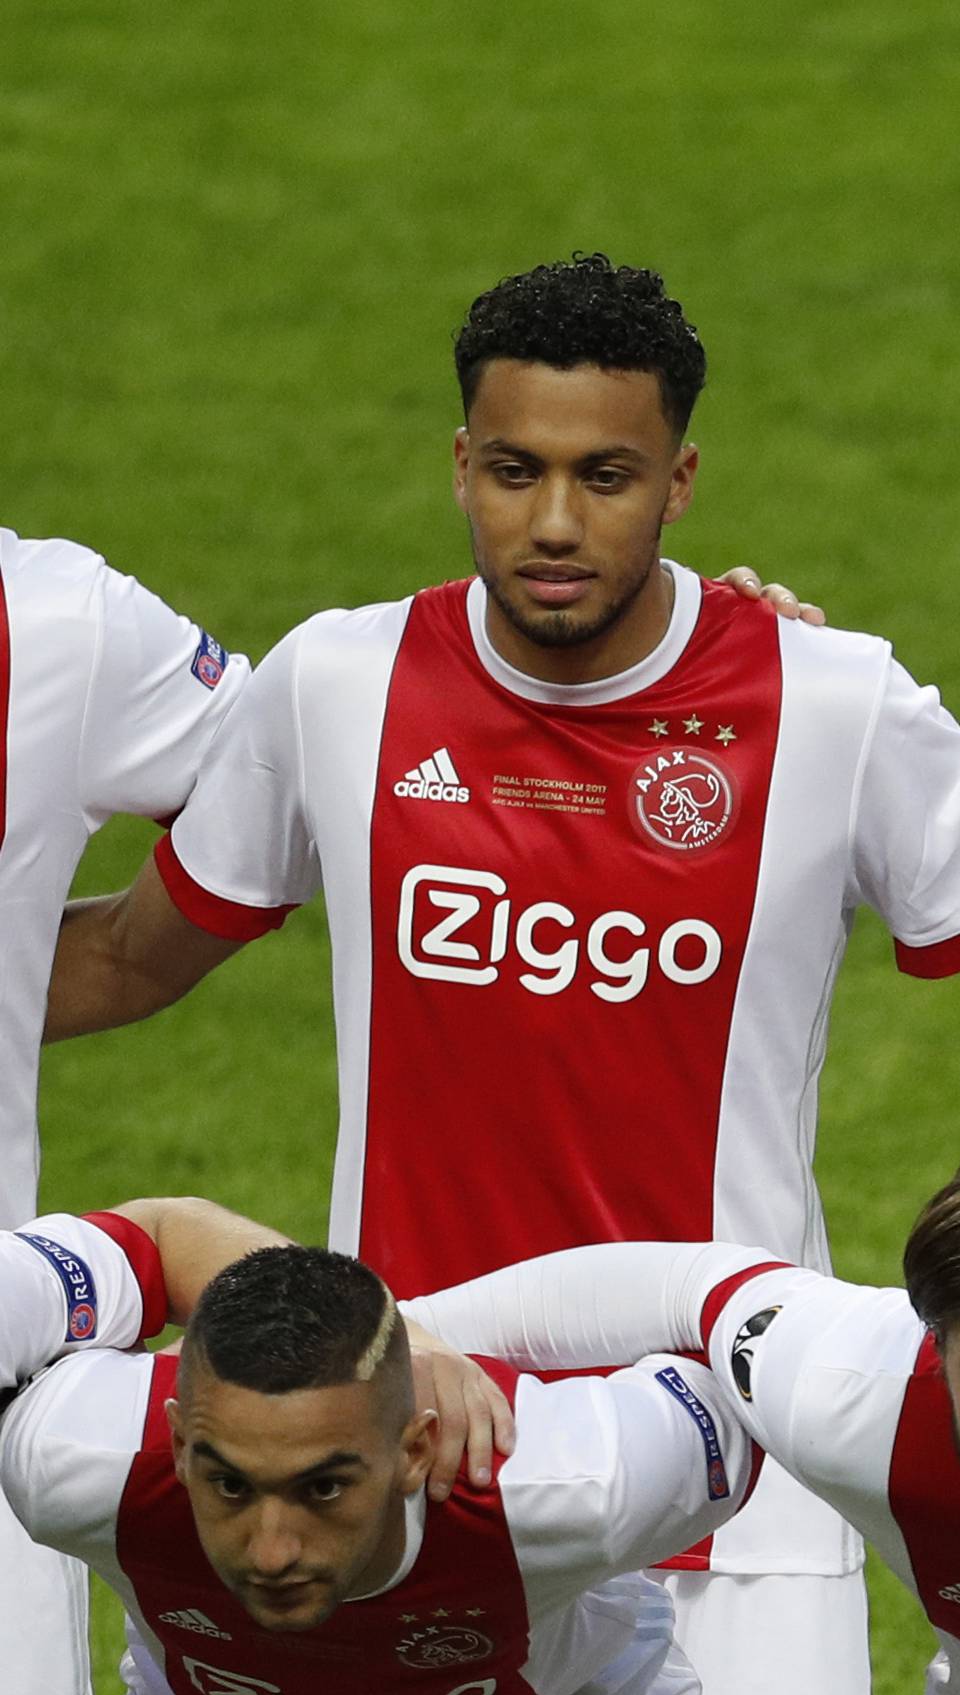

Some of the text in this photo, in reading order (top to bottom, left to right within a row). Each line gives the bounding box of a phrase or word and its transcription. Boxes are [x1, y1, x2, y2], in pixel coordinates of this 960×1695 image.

[493, 775, 607, 794] FINAL STOCKHOLM 2017
[637, 751, 685, 792] AJAX
[393, 778, 471, 803] adidas
[492, 787, 531, 798] FRIENDS
[532, 790, 565, 802] ARENA
[572, 795, 584, 804] 24
[586, 796, 607, 806] MAY
[398, 864, 722, 1003] Ziggo
[661, 1371, 719, 1457] RESPECT
[158, 1613, 233, 1641] adidas
